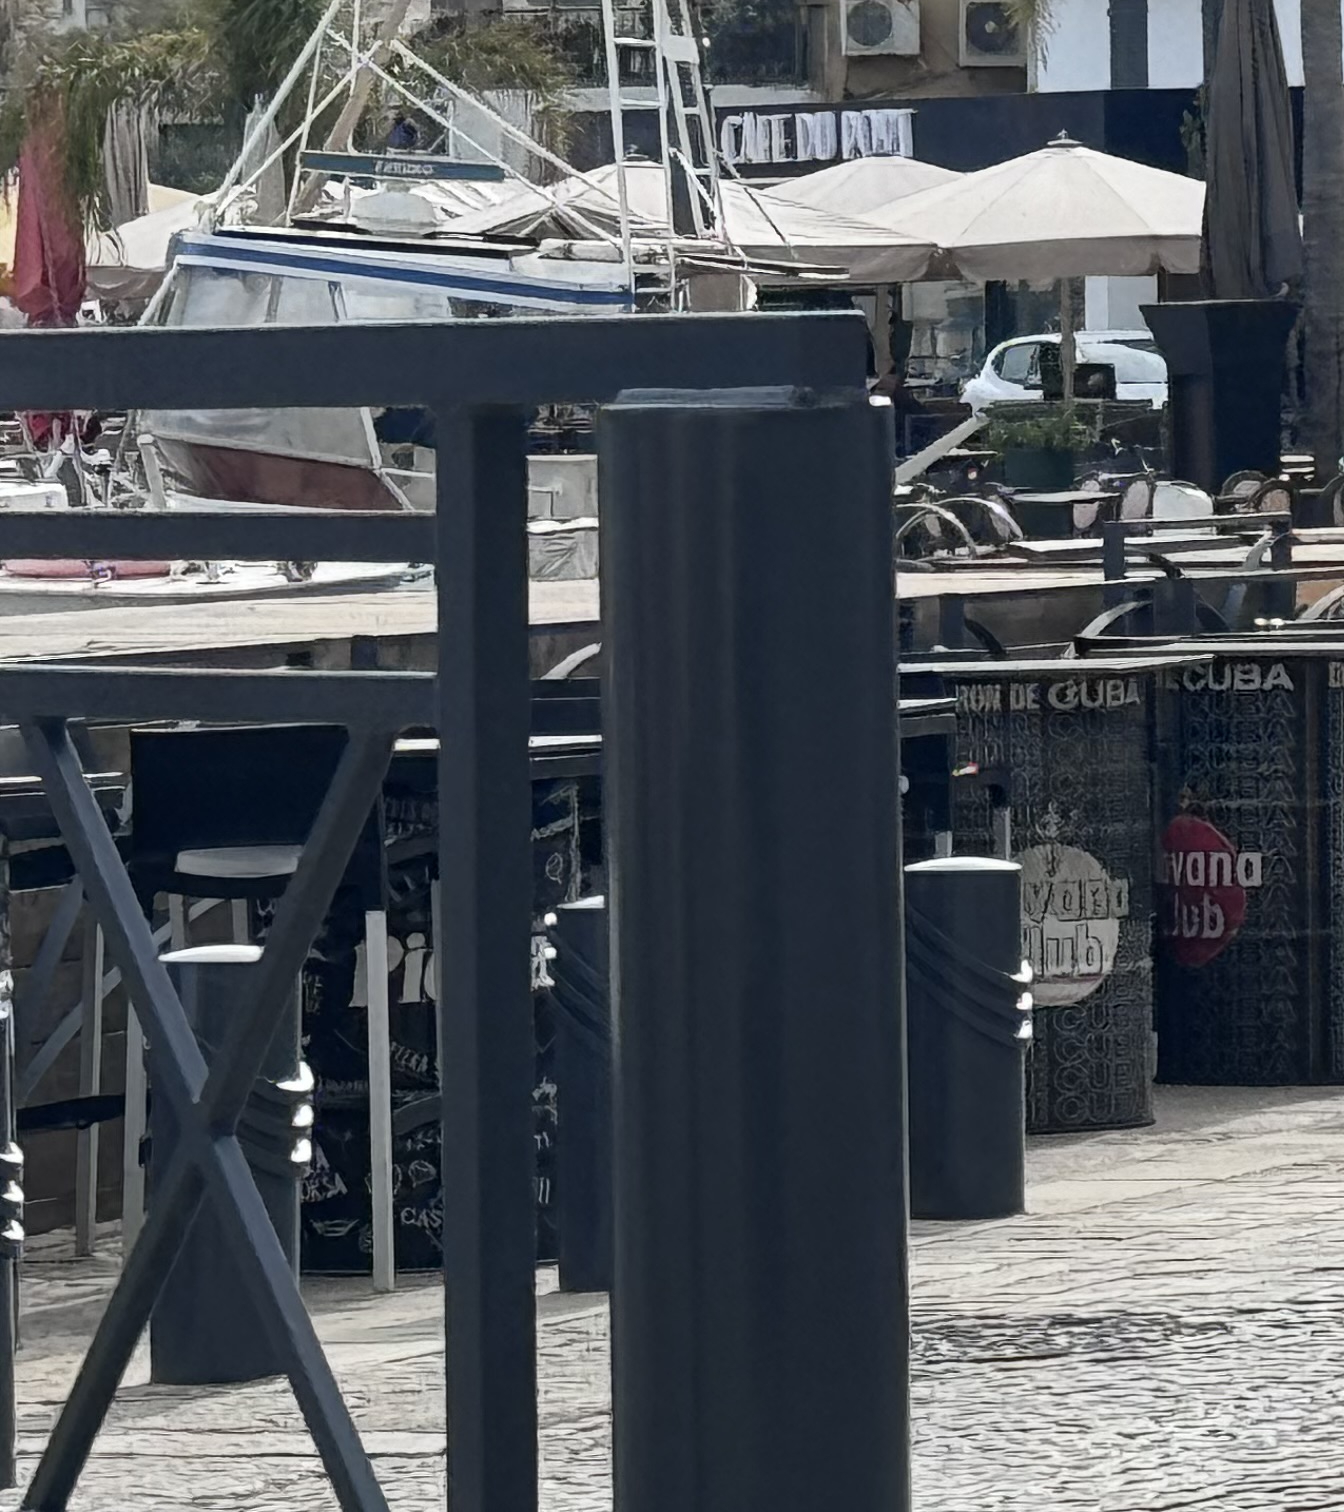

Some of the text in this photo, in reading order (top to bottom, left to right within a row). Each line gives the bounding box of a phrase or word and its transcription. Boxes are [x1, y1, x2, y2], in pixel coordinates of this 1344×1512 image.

[1183, 662, 1294, 691] CUBA
[1009, 682, 1042, 711] DE
[1047, 676, 1142, 712] CUBA
